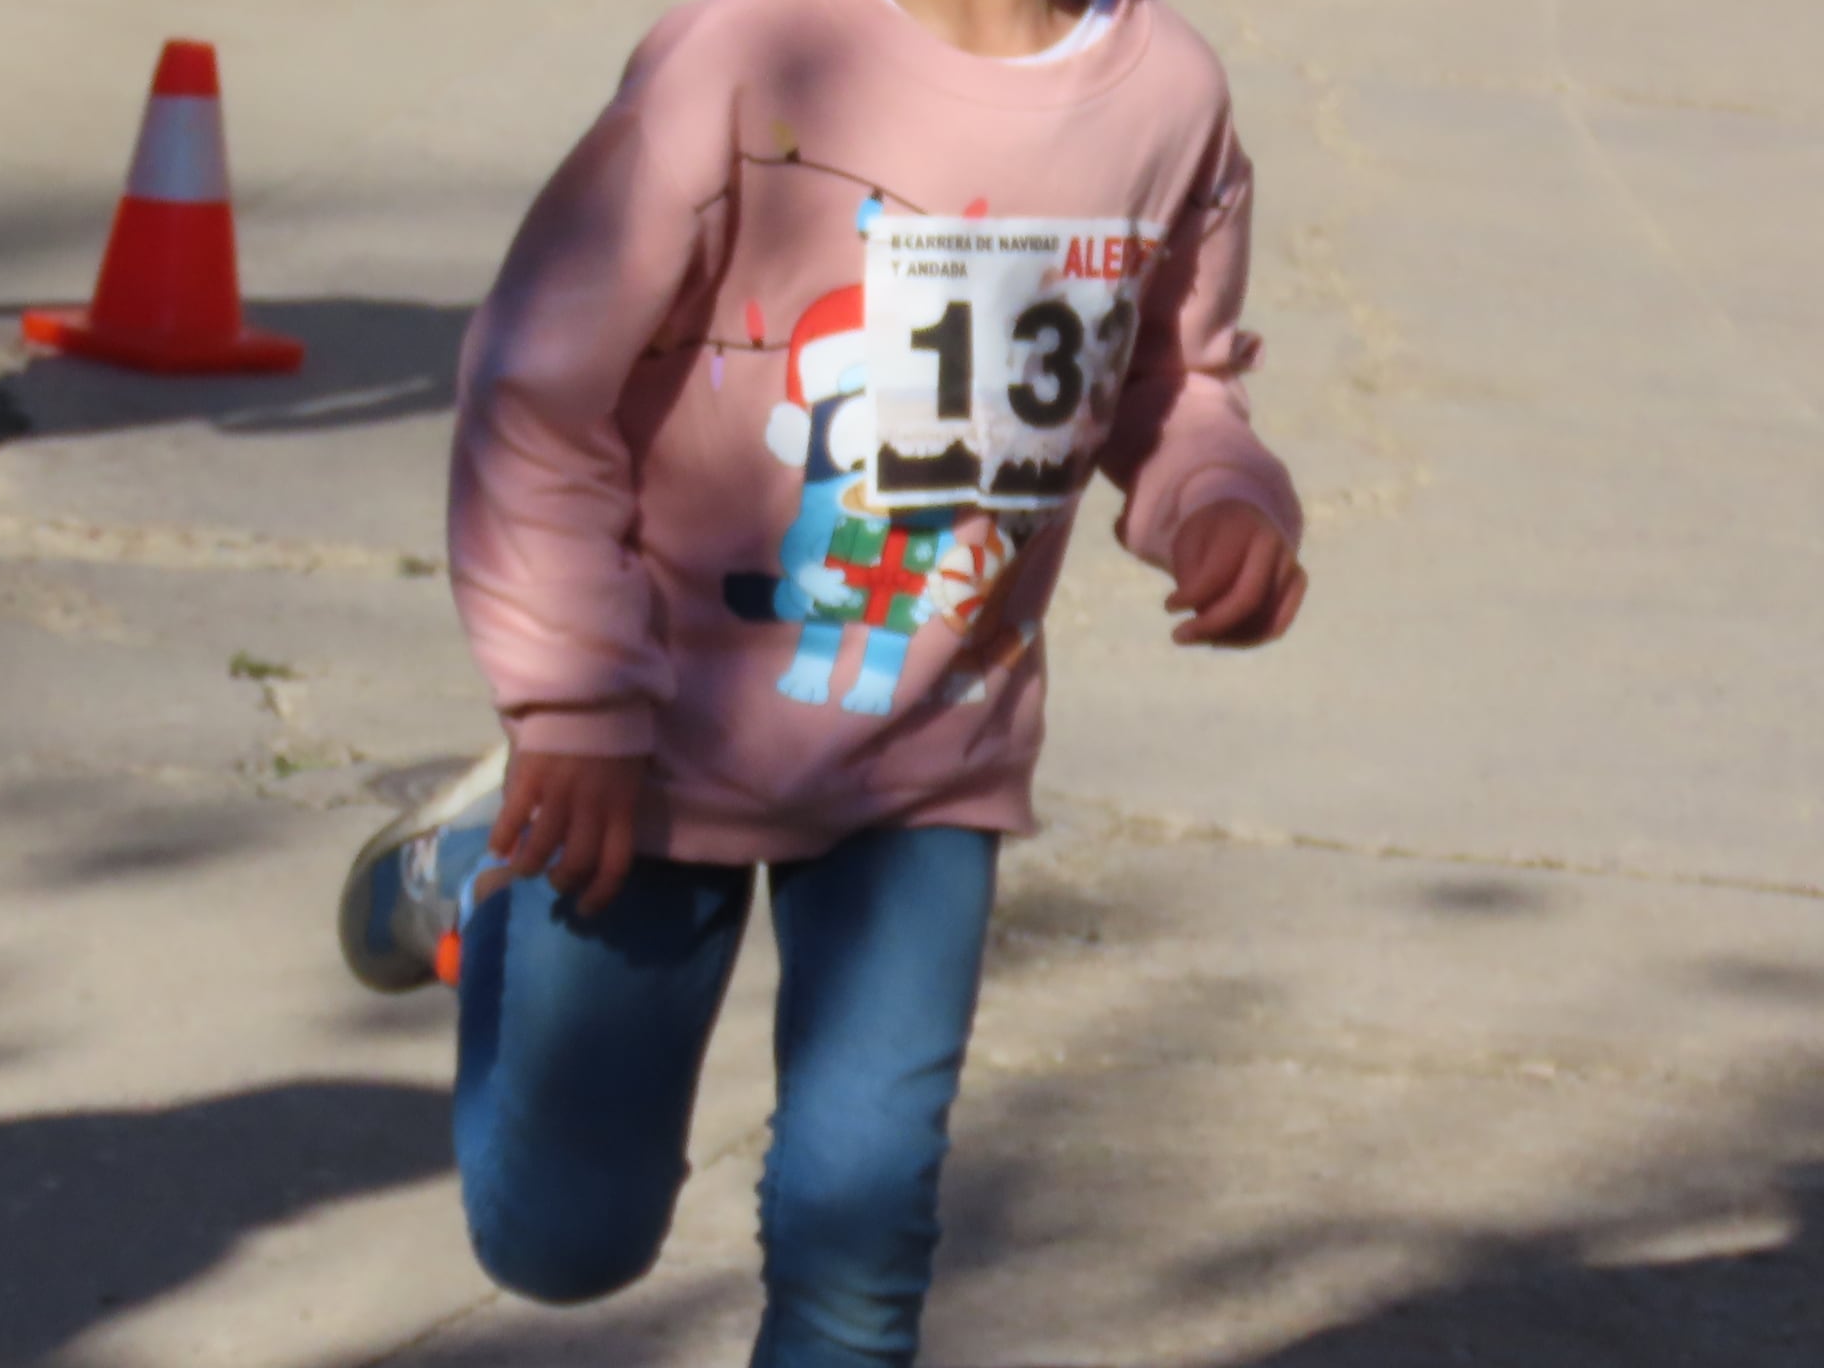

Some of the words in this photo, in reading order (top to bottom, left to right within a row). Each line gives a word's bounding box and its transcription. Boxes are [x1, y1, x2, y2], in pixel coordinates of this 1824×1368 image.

[905, 235, 973, 251] CARRERA
[976, 235, 994, 251] DE
[999, 235, 1060, 251] NAVIDAD
